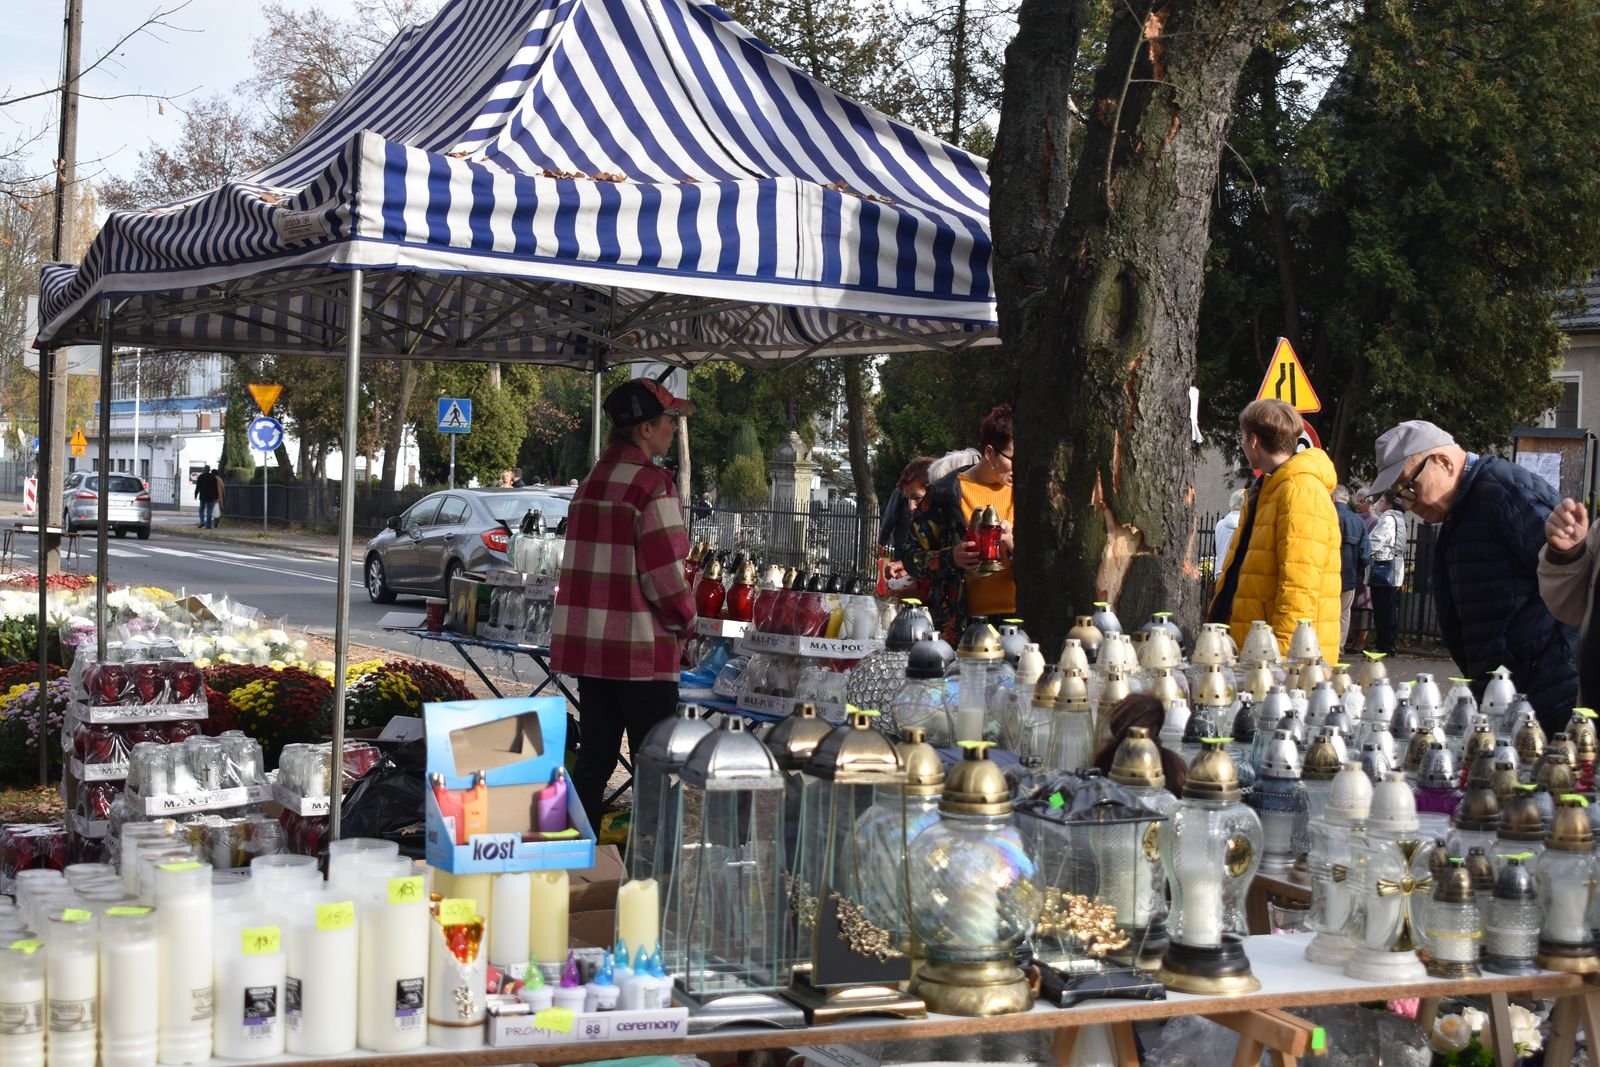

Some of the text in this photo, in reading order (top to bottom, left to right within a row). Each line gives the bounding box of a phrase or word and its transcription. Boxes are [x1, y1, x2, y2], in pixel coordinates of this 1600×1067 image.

[809, 641, 864, 652] MAX-POL
[473, 838, 515, 861] kost
[585, 1024, 600, 1034] 88
[616, 1019, 681, 1032] ceremony
